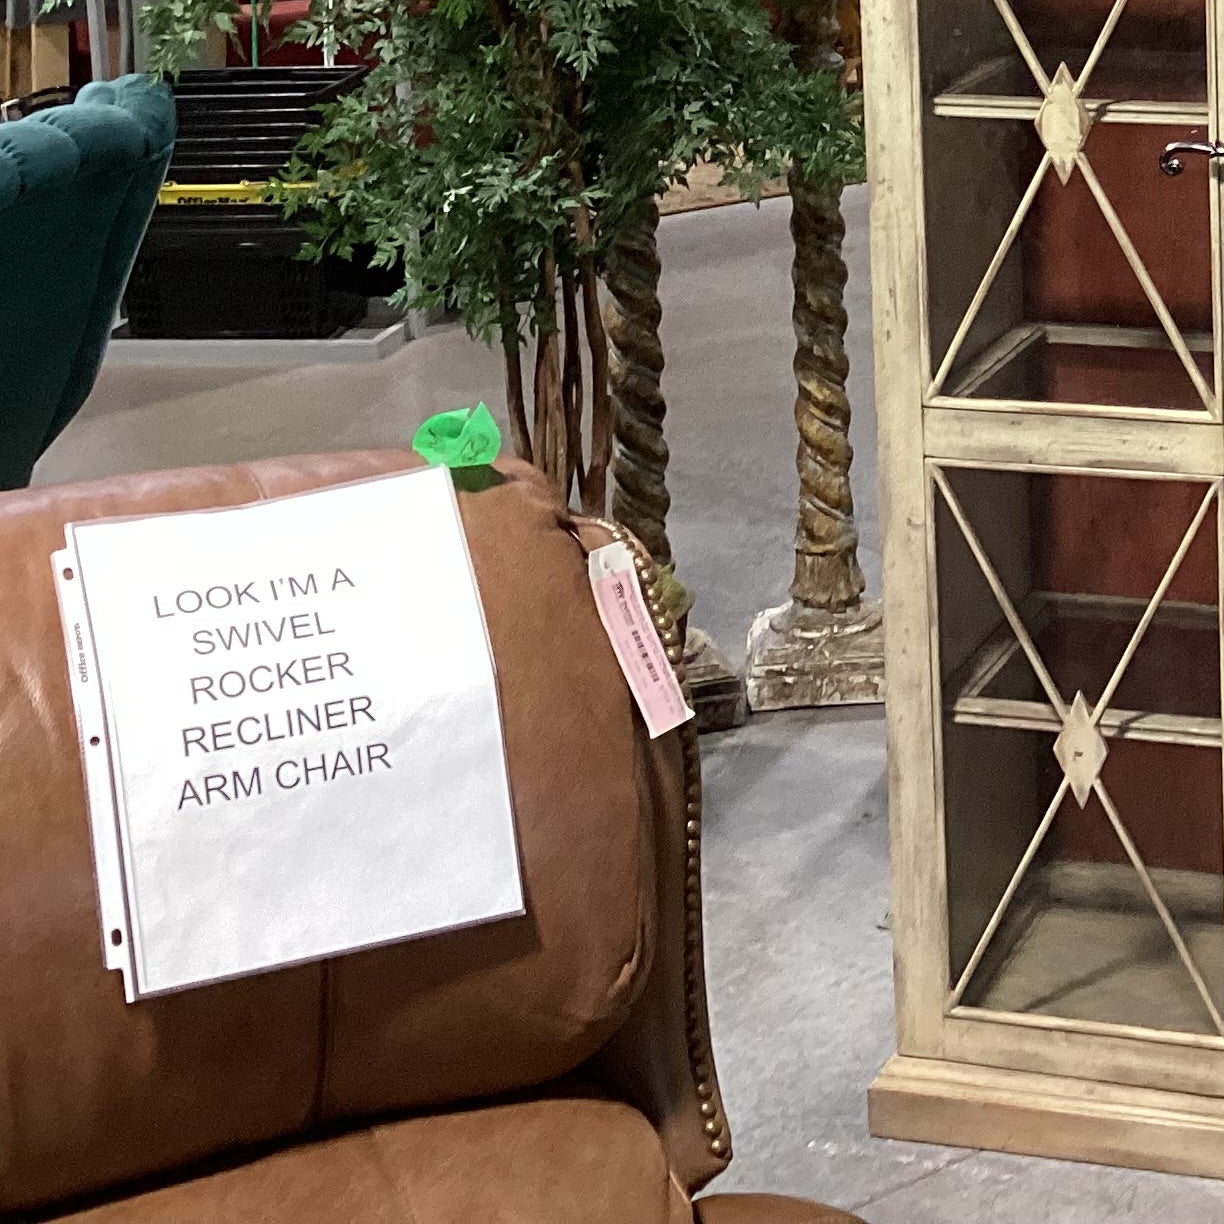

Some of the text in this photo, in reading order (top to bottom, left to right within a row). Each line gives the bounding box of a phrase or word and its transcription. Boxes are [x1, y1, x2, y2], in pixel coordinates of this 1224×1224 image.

[153, 567, 356, 619] LOOK I'M A
[192, 611, 336, 656] SWIVEL
[78, 652, 89, 683] Office
[189, 651, 355, 705] ROCKER
[181, 695, 377, 758] RECLINER
[177, 742, 392, 812] ARM CHAIR
